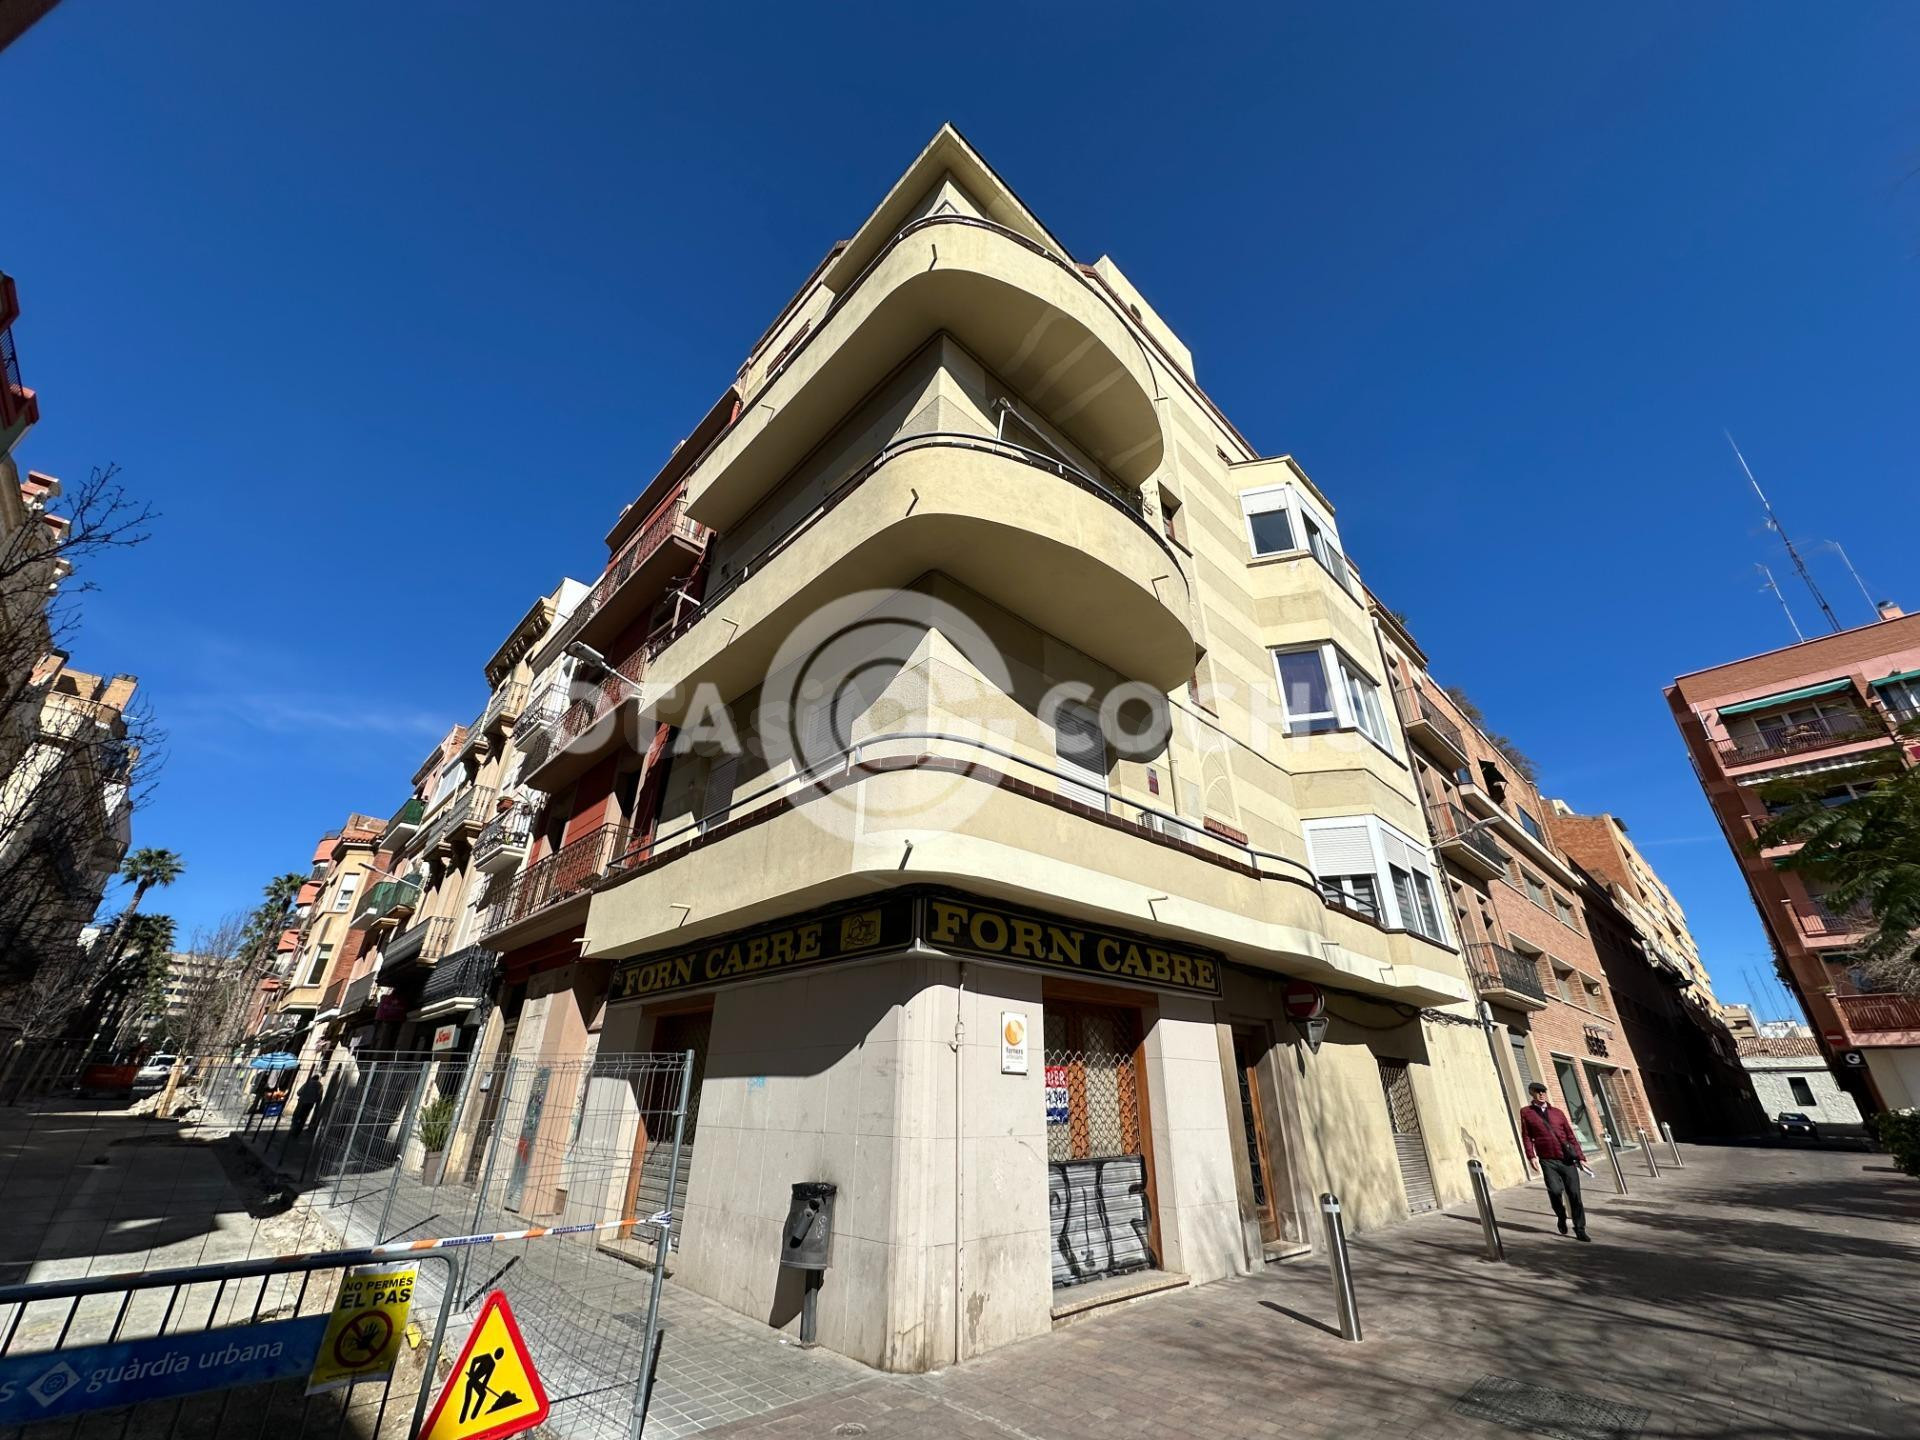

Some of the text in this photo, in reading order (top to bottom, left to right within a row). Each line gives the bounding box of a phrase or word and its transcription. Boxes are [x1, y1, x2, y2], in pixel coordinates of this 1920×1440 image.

[622, 923, 823, 996] FORN CABRE
[931, 902, 1217, 989] FORN CABRE
[341, 1288, 411, 1309] EL PAS
[344, 1281, 362, 1292] NO
[86, 1351, 189, 1393] guàrdia
[198, 1341, 284, 1369] urbana
